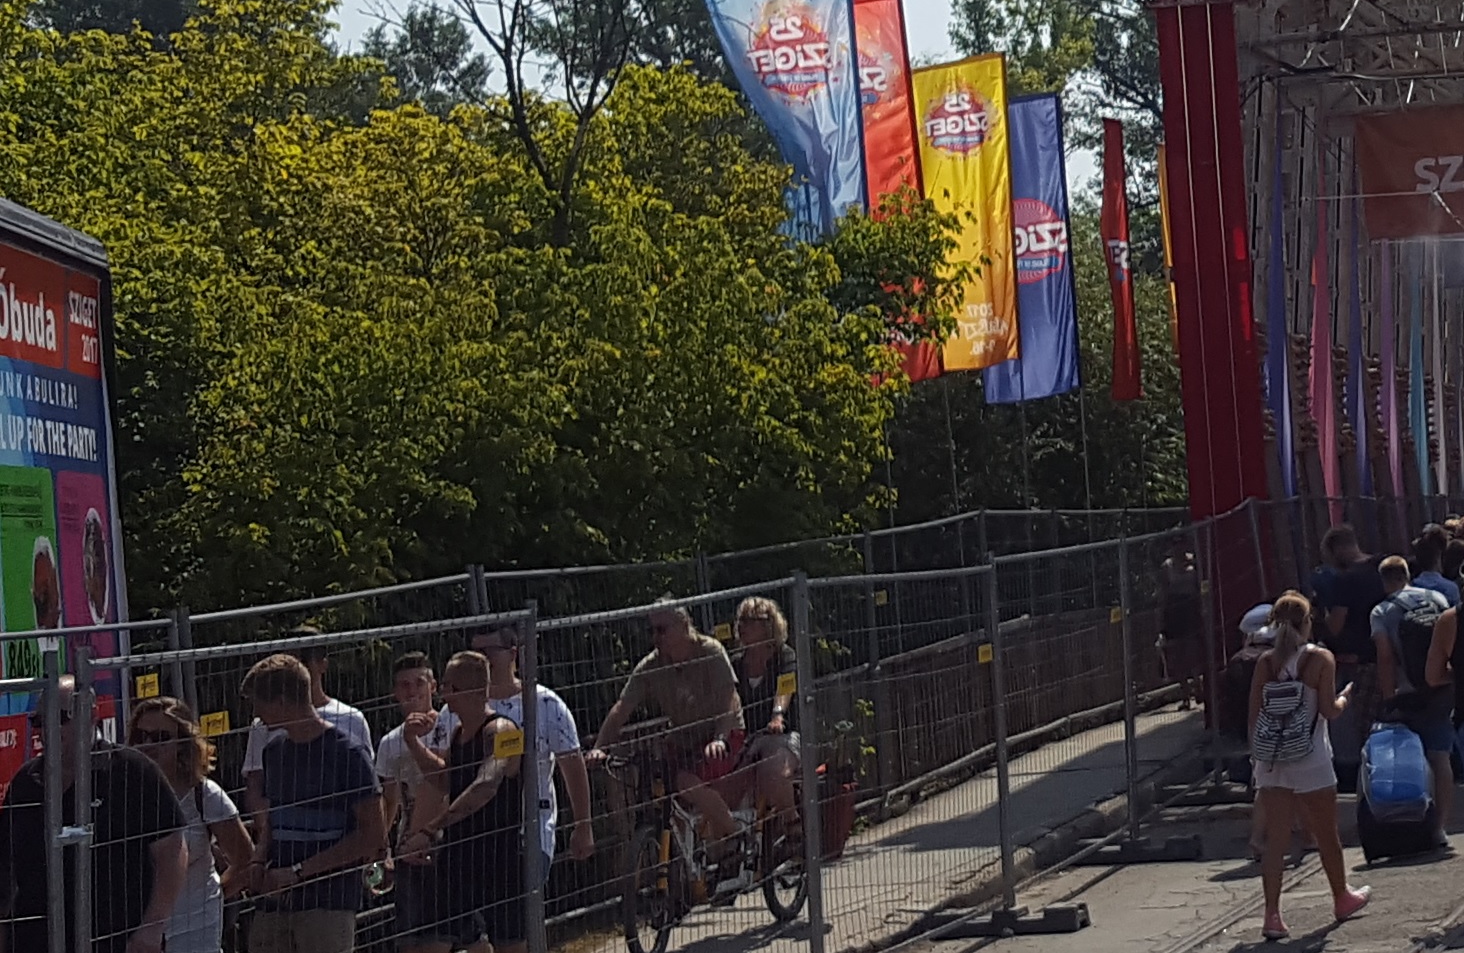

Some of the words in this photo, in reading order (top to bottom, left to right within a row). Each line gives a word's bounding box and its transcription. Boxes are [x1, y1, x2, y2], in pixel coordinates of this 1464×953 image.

[68, 290, 97, 329] SZIGET
[8, 414, 24, 451] UP
[26, 416, 47, 454] FOR
[45, 420, 66, 456] THE
[66, 423, 97, 462] PARTY!
